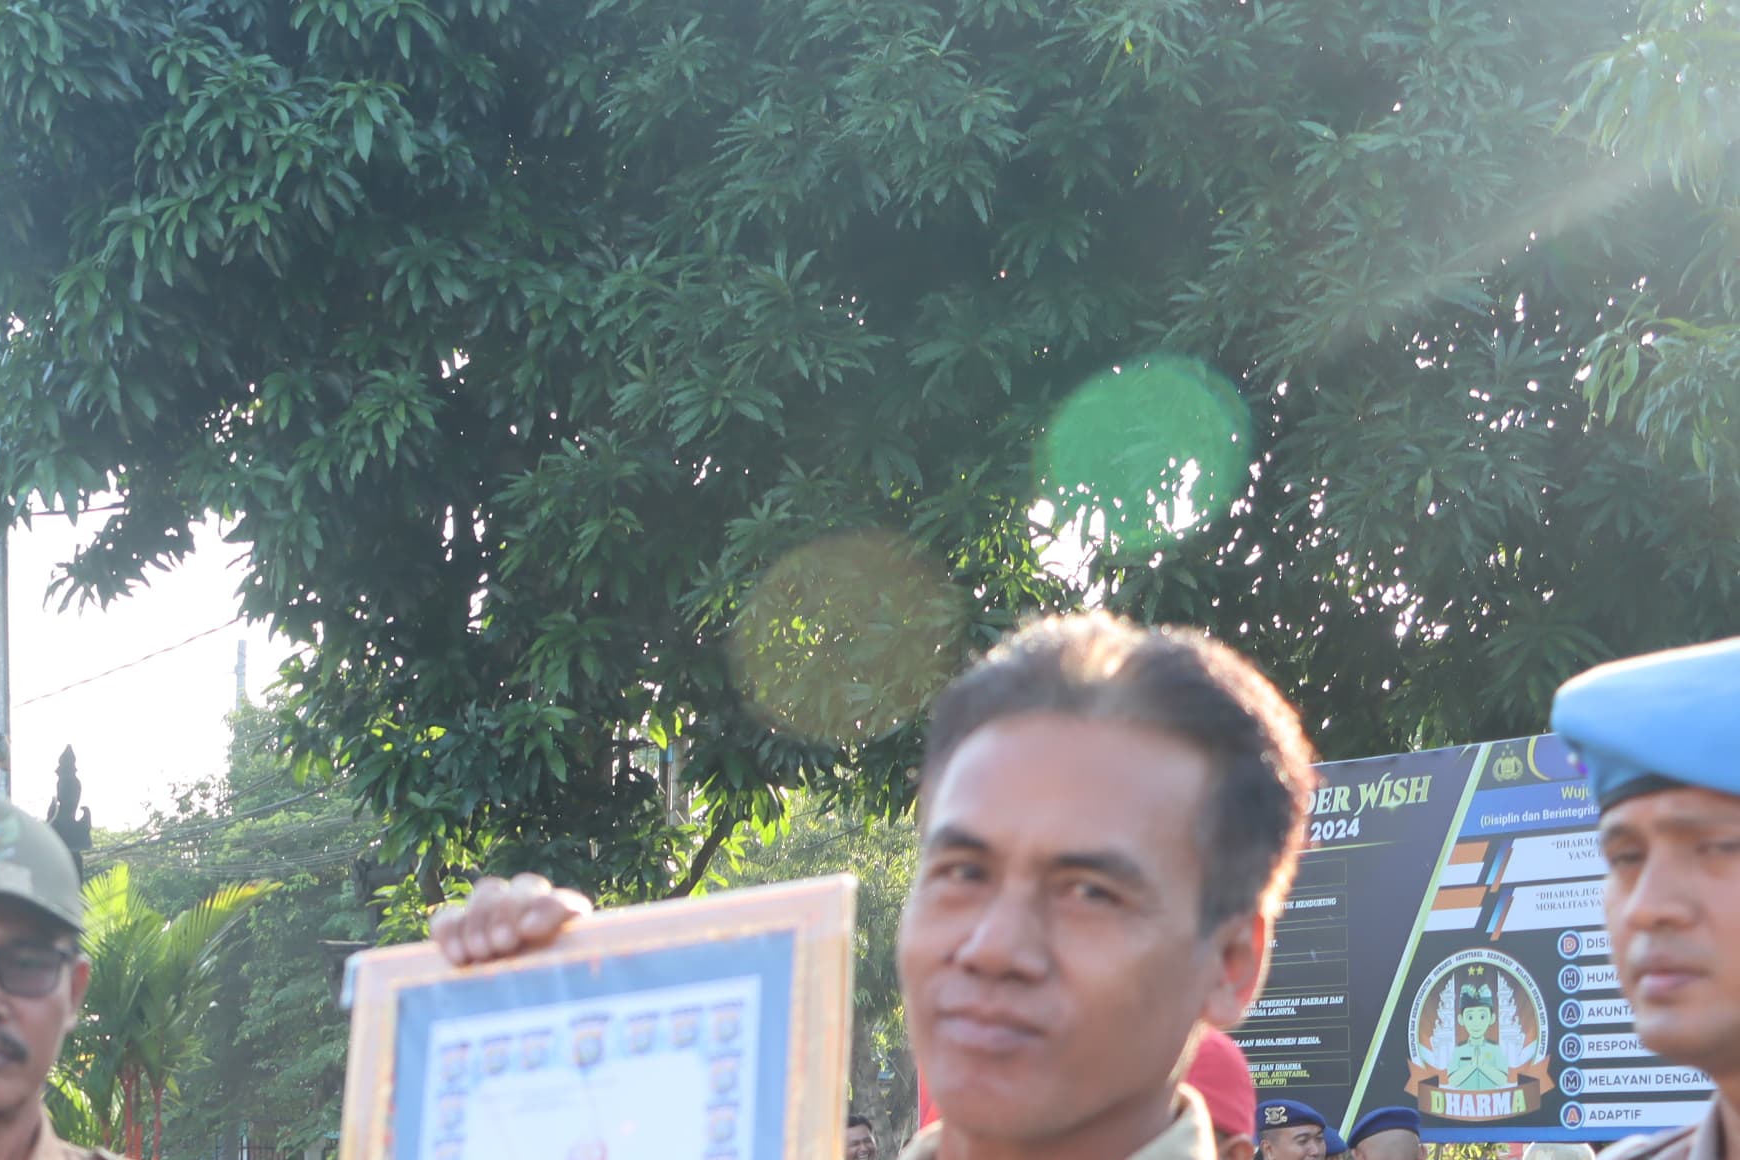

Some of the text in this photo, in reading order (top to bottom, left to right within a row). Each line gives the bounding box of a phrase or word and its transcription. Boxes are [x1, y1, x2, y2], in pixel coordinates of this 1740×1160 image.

[1354, 772, 1432, 816] WISH
[1480, 813, 1520, 828] (Disiplin
[1522, 810, 1540, 822] dan
[1309, 817, 1360, 841] 2024
[1535, 900, 1588, 912] MORALITAS
[1329, 995, 1344, 1004] DAN
[1261, 1063, 1274, 1072] DAN
[1588, 1074, 1651, 1086] MELAYANI
[1655, 1071, 1710, 1084] DENGAN
[1430, 1089, 1526, 1118] DHARMA
[1589, 1108, 1642, 1121] ADAPTIF
